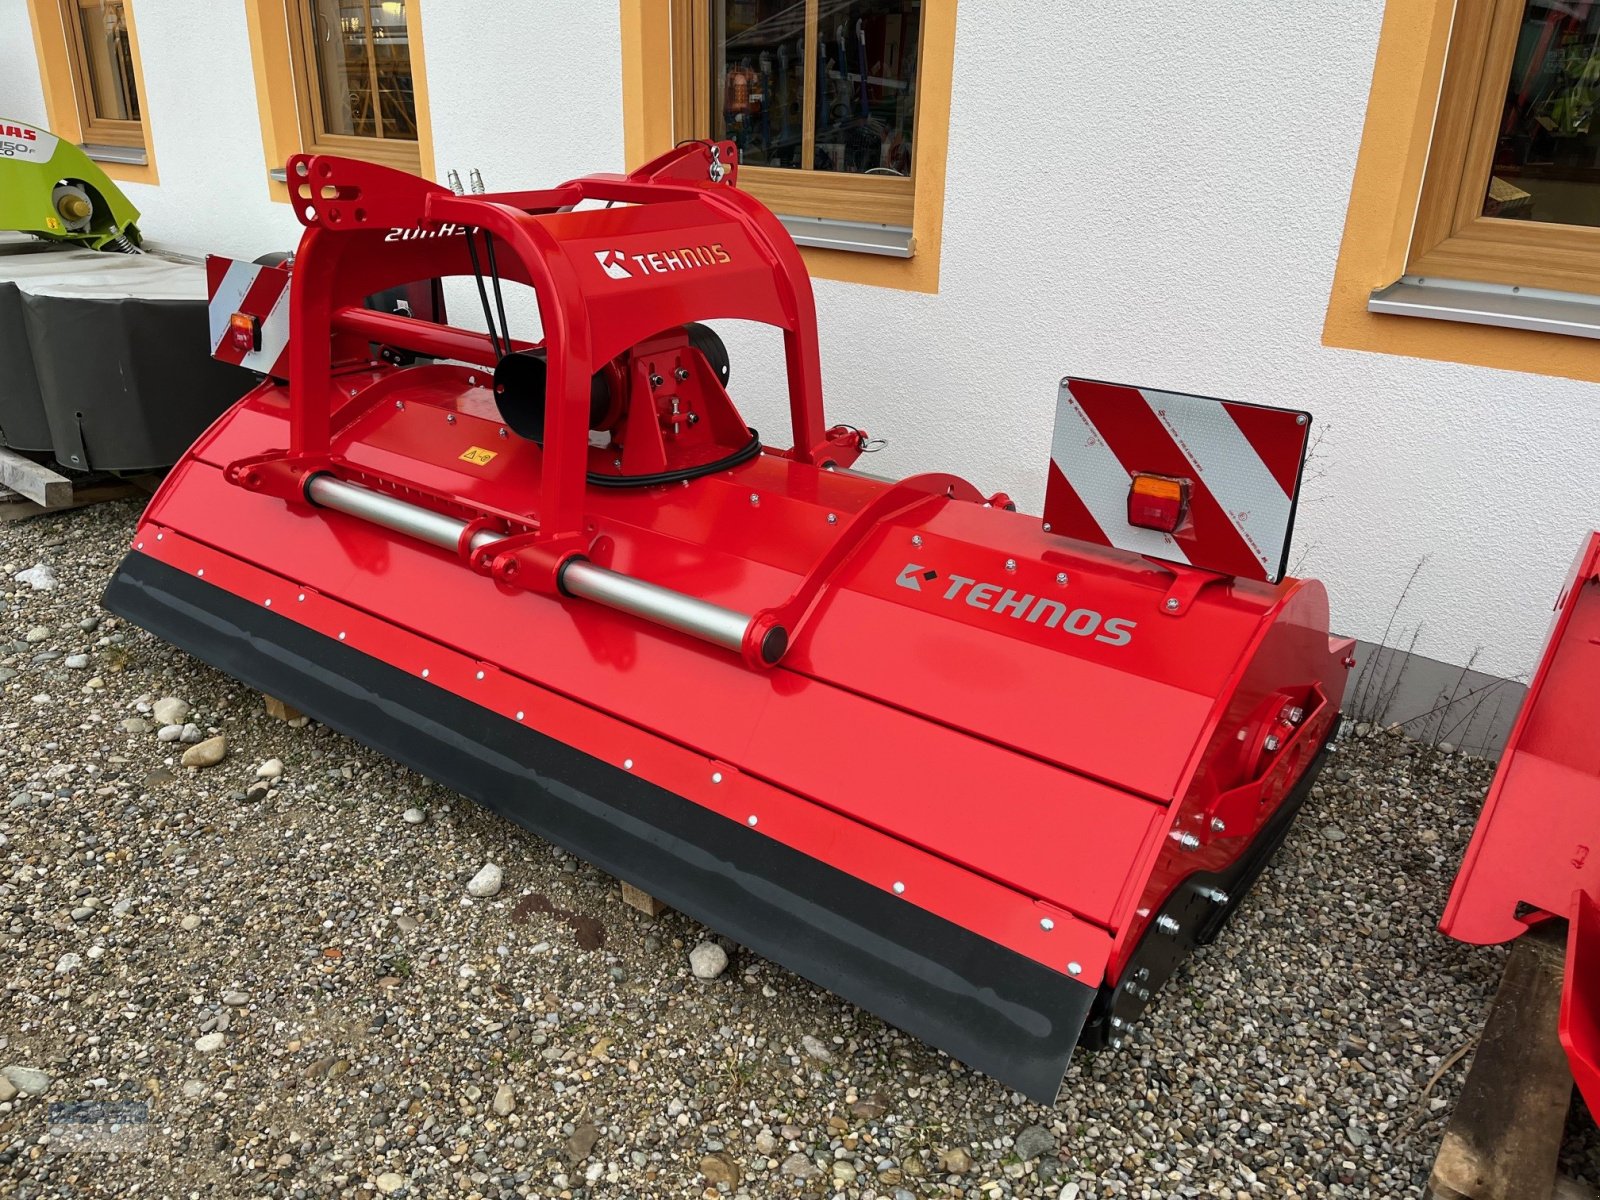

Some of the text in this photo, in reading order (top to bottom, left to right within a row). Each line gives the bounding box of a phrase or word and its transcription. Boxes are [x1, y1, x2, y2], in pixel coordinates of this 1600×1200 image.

[0, 124, 37, 141] AS
[631, 244, 731, 275] TEHNOS
[943, 574, 1137, 647] TEHNOS
